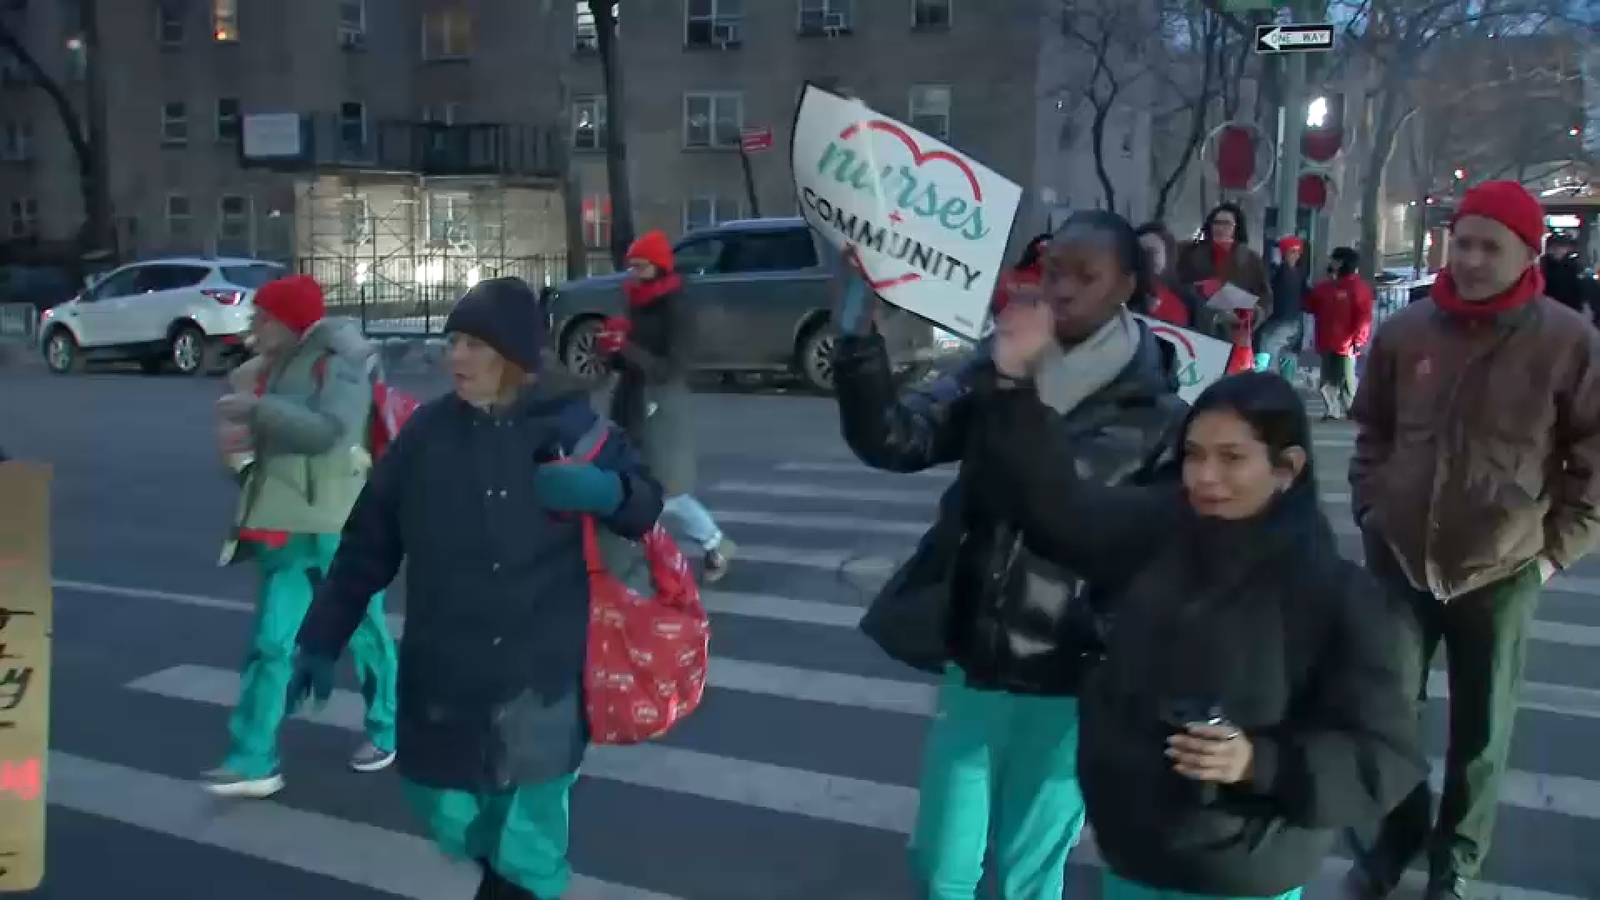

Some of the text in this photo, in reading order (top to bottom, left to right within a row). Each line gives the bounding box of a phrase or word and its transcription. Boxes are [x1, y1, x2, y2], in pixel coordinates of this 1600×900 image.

[1270, 32, 1326, 43] ONE WAY
[802, 186, 982, 291] COMMUNITY
[816, 141, 991, 241] nurses
